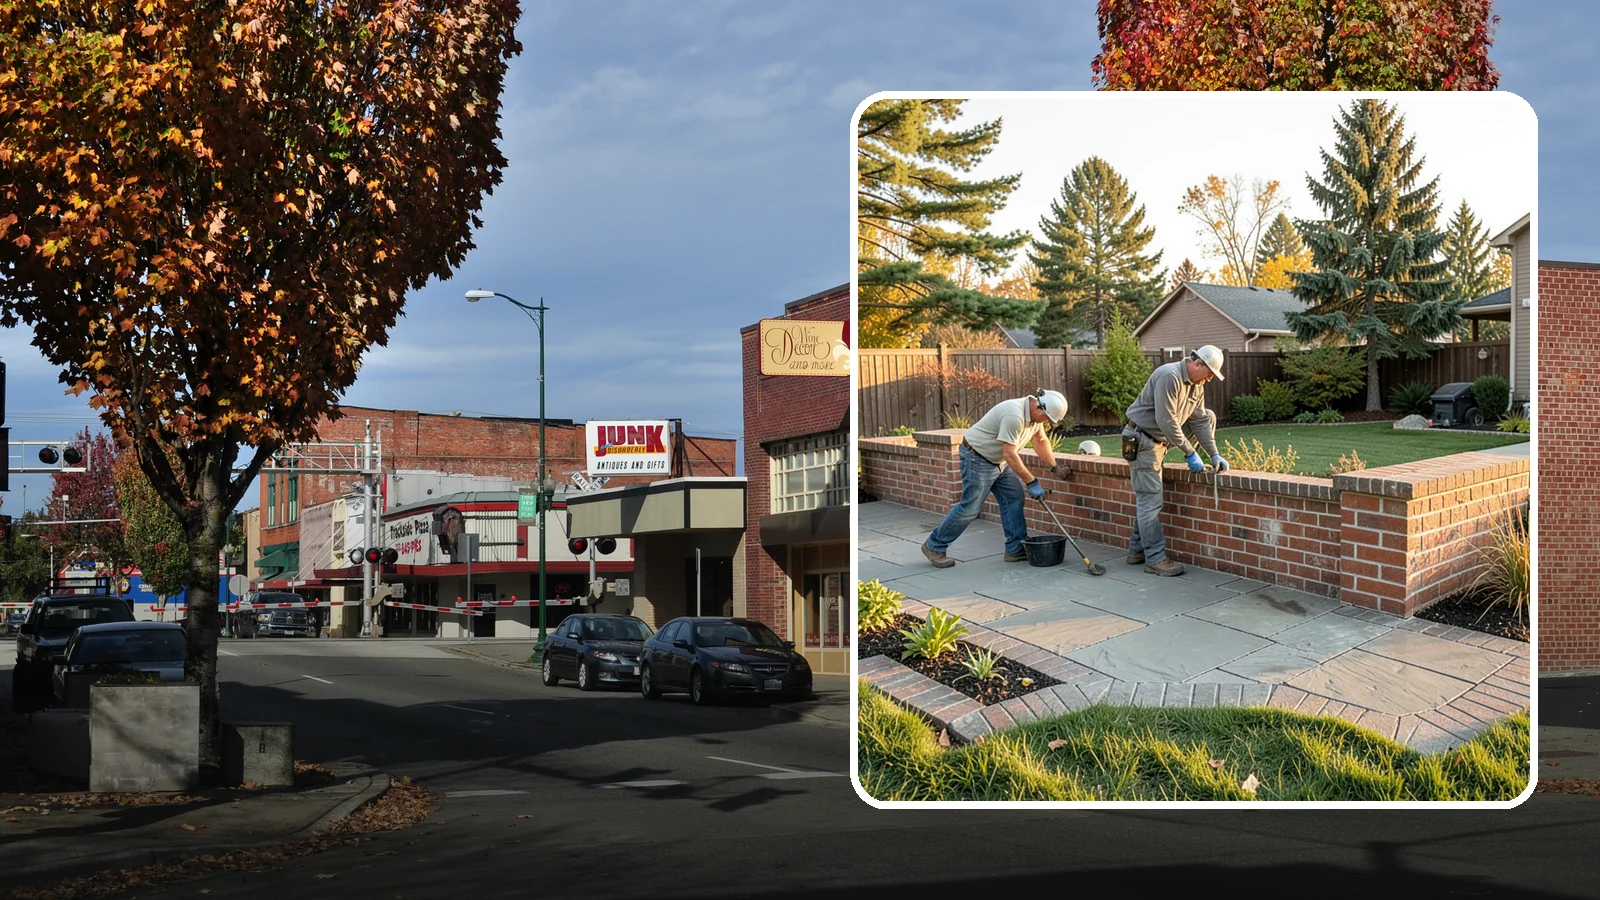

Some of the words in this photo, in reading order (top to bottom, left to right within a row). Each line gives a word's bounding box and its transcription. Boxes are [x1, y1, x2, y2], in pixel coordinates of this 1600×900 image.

[596, 425, 664, 457] JUNK
[607, 446, 645, 454] DISORDERLY
[597, 461, 628, 470] ANTIQUES
[631, 461, 643, 469] AND
[647, 460, 665, 469] GIFTS
[415, 519, 429, 534] Pizza
